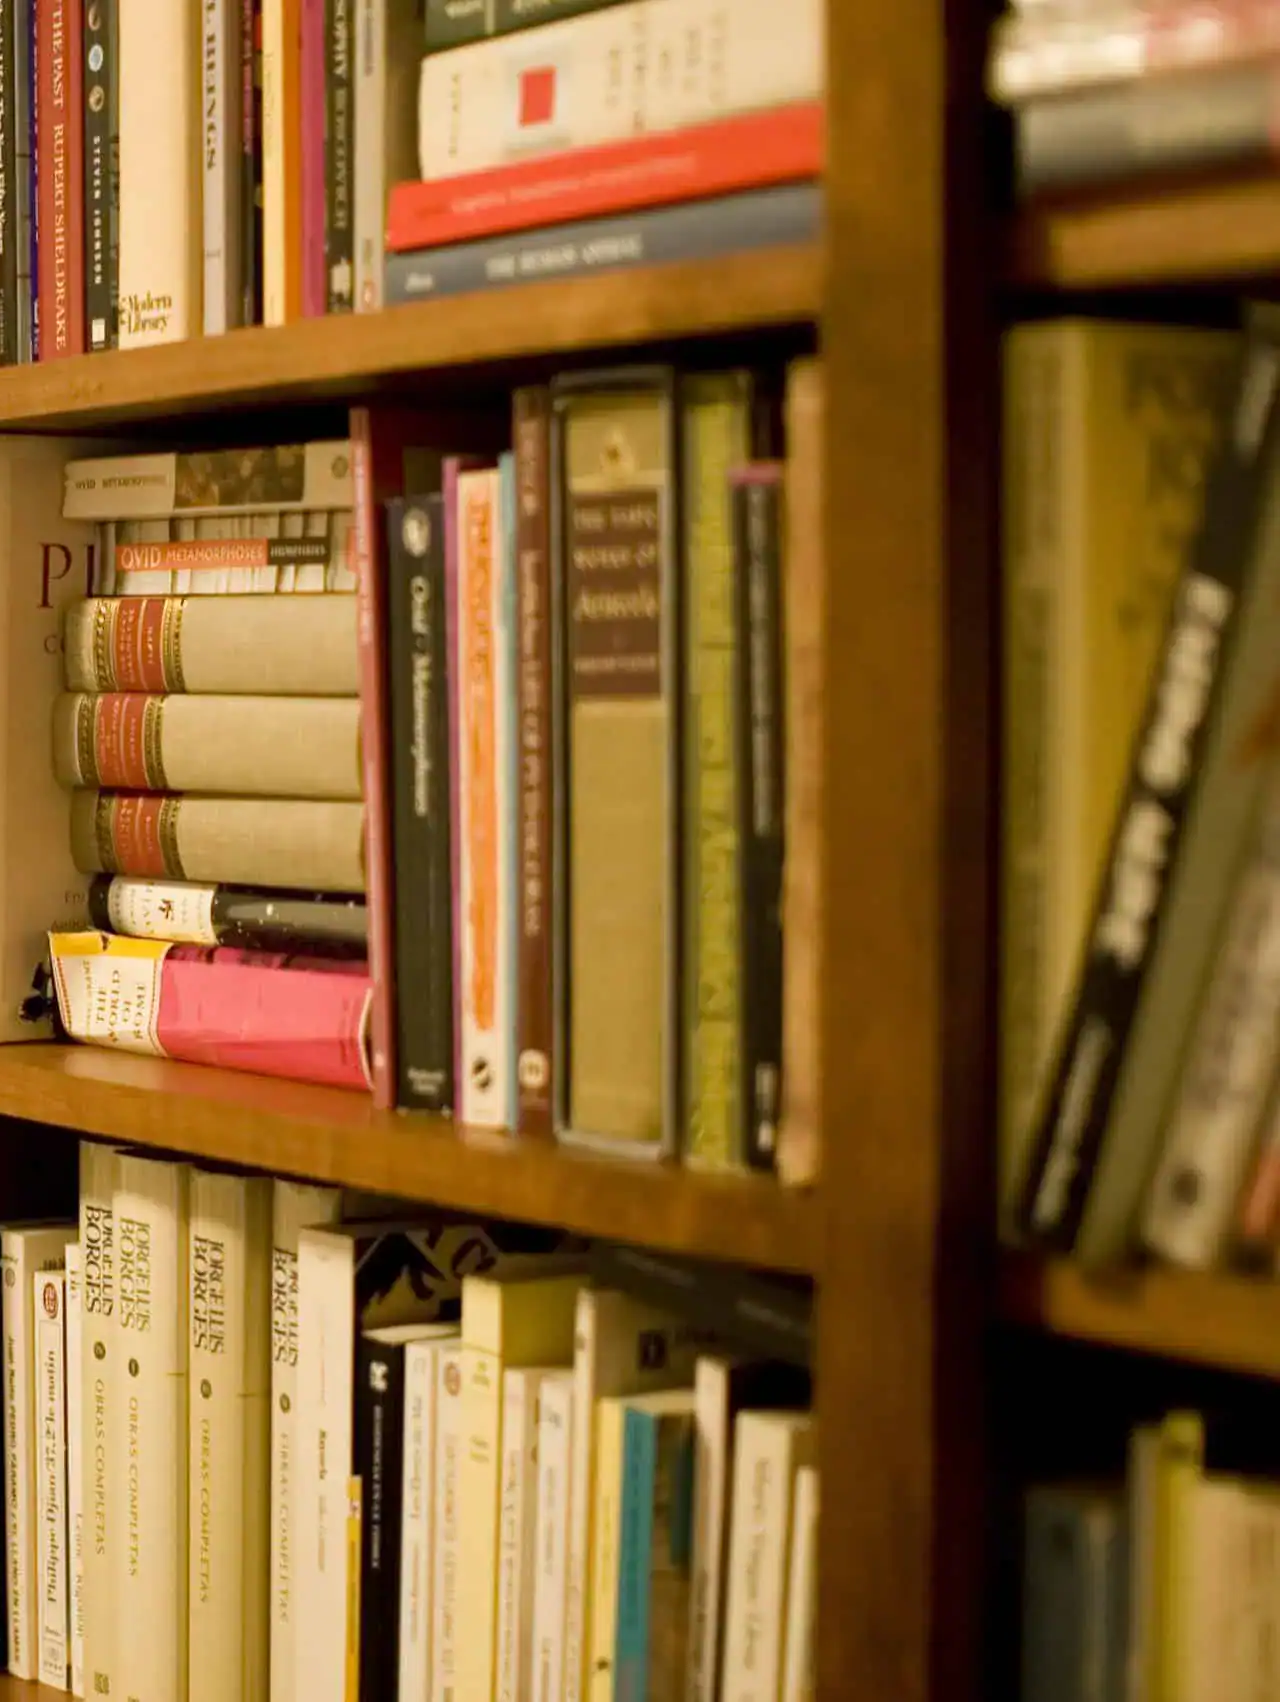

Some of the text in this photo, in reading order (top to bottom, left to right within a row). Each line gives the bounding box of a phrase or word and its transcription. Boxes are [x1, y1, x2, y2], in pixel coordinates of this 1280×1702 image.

[52, 8, 67, 351] THE PAST RUPERT SHELDRAKE
[92, 137, 102, 285] STEVEN JOHNSON
[128, 291, 172, 311] Modern
[128, 311, 168, 334] Library
[121, 546, 162, 570] OVID
[166, 543, 264, 563] METAMORPHOSES
[95, 988, 107, 1024] THE
[107, 969, 121, 1043] WORLD
[132, 983, 146, 1040] ROME
[85, 1204, 102, 1313] BORGES
[120, 1216, 136, 1329] BORGES
[136, 1221, 152, 1332] JORGE LUIS
[192, 1234, 208, 1350] BORGES
[209, 1239, 225, 1354] JORGE LUIS
[273, 1246, 288, 1362] BORGES
[43, 1350, 56, 1402] matin
[95, 1378, 106, 1555] OBRAS COMPLETAS
[128, 1395, 139, 1578] OBRAS COMPLETAS
[199, 1418, 210, 1604] OBRAS COMPLETAS
[45, 1528, 60, 1604] Philippe
